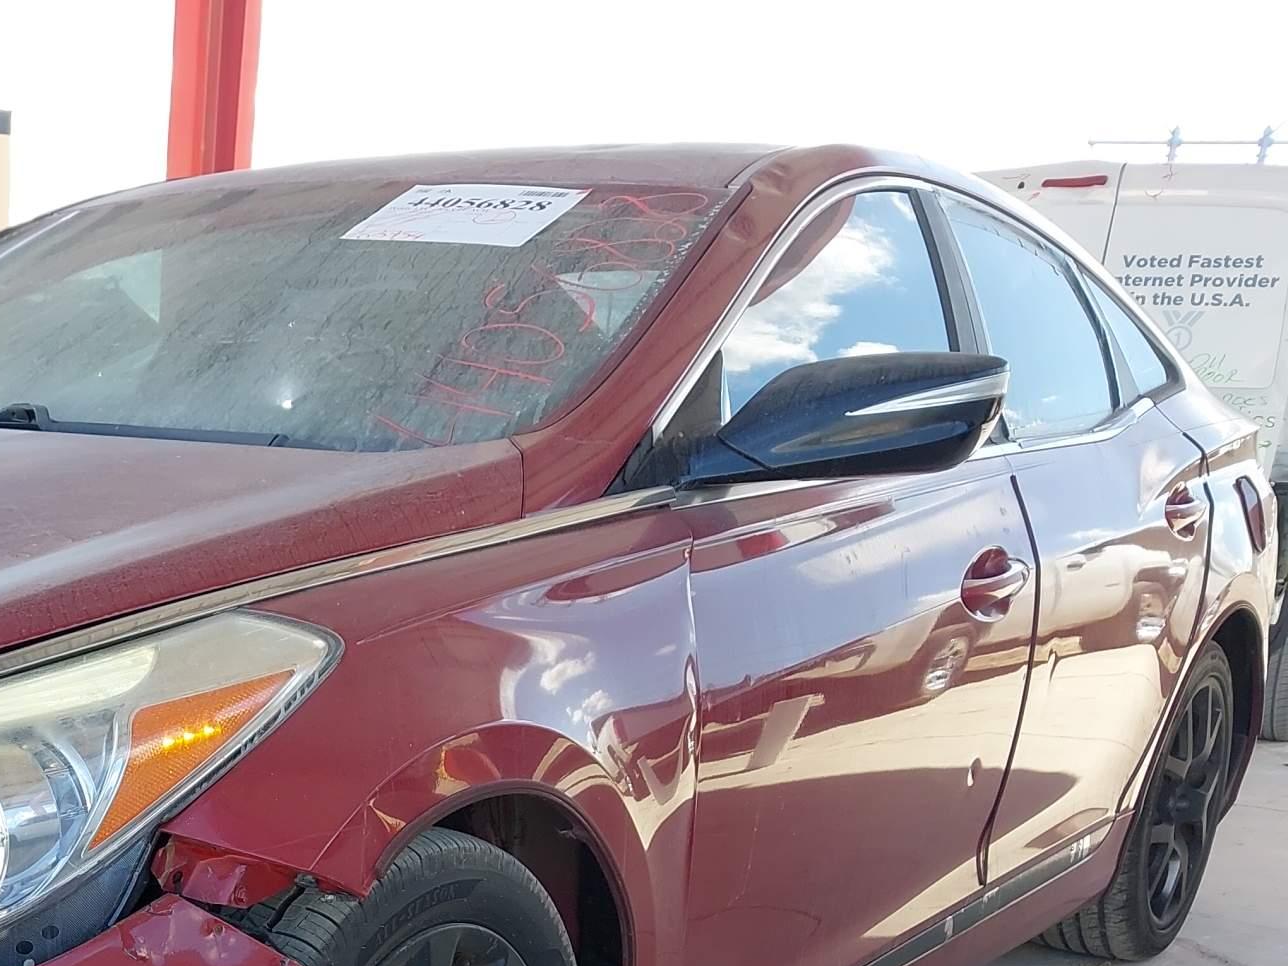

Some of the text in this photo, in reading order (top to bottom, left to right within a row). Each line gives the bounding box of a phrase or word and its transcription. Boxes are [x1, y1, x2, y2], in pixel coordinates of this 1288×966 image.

[407, 196, 553, 212] 44056828
[1123, 254, 1264, 268] Voted Fastest
[1114, 274, 1280, 288] nternet Provider
[1152, 292, 1184, 306] the
[1190, 293, 1250, 307] U.S.A.
